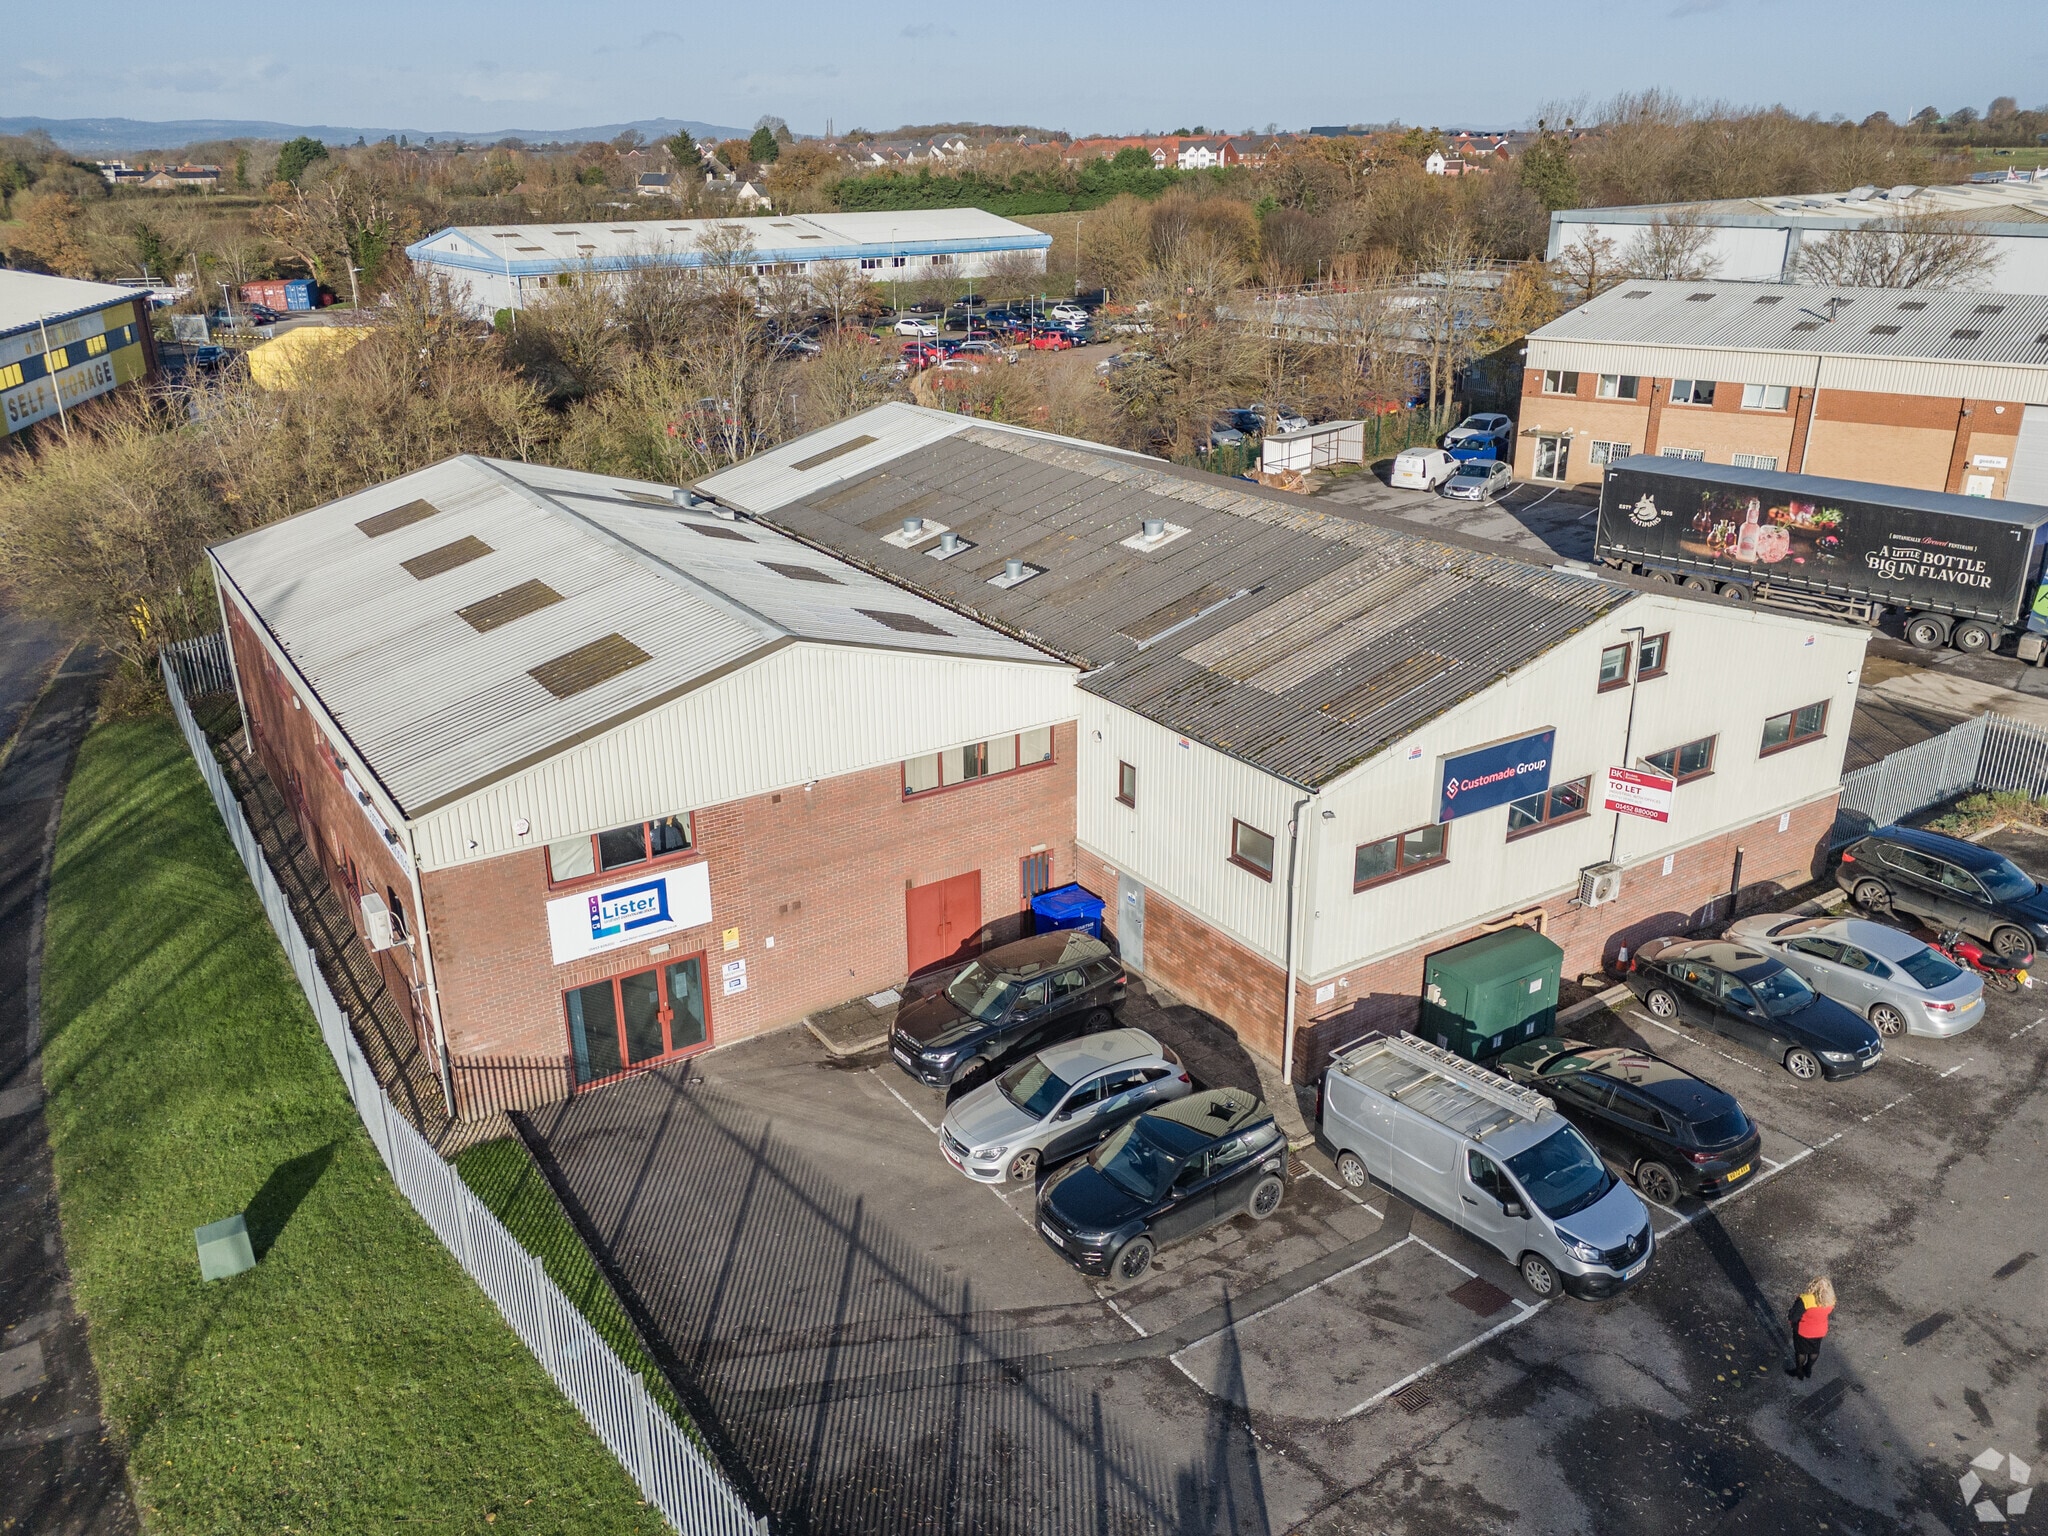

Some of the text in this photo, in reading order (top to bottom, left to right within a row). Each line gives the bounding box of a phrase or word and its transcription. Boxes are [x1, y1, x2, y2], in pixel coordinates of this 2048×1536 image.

[8, 386, 45, 422] SELF
[1628, 513, 1662, 528] FENTIMANS
[1879, 545, 1986, 573] A LITTLE BOTTLE
[1899, 562, 1917, 576] IN
[1919, 565, 1992, 589] FLAVOUR
[1461, 759, 1547, 791] Customade Group
[1611, 769, 1623, 778] BK
[1610, 781, 1642, 794] TO LET
[1615, 803, 1633, 811] 01452
[602, 896, 655, 919] Lister
